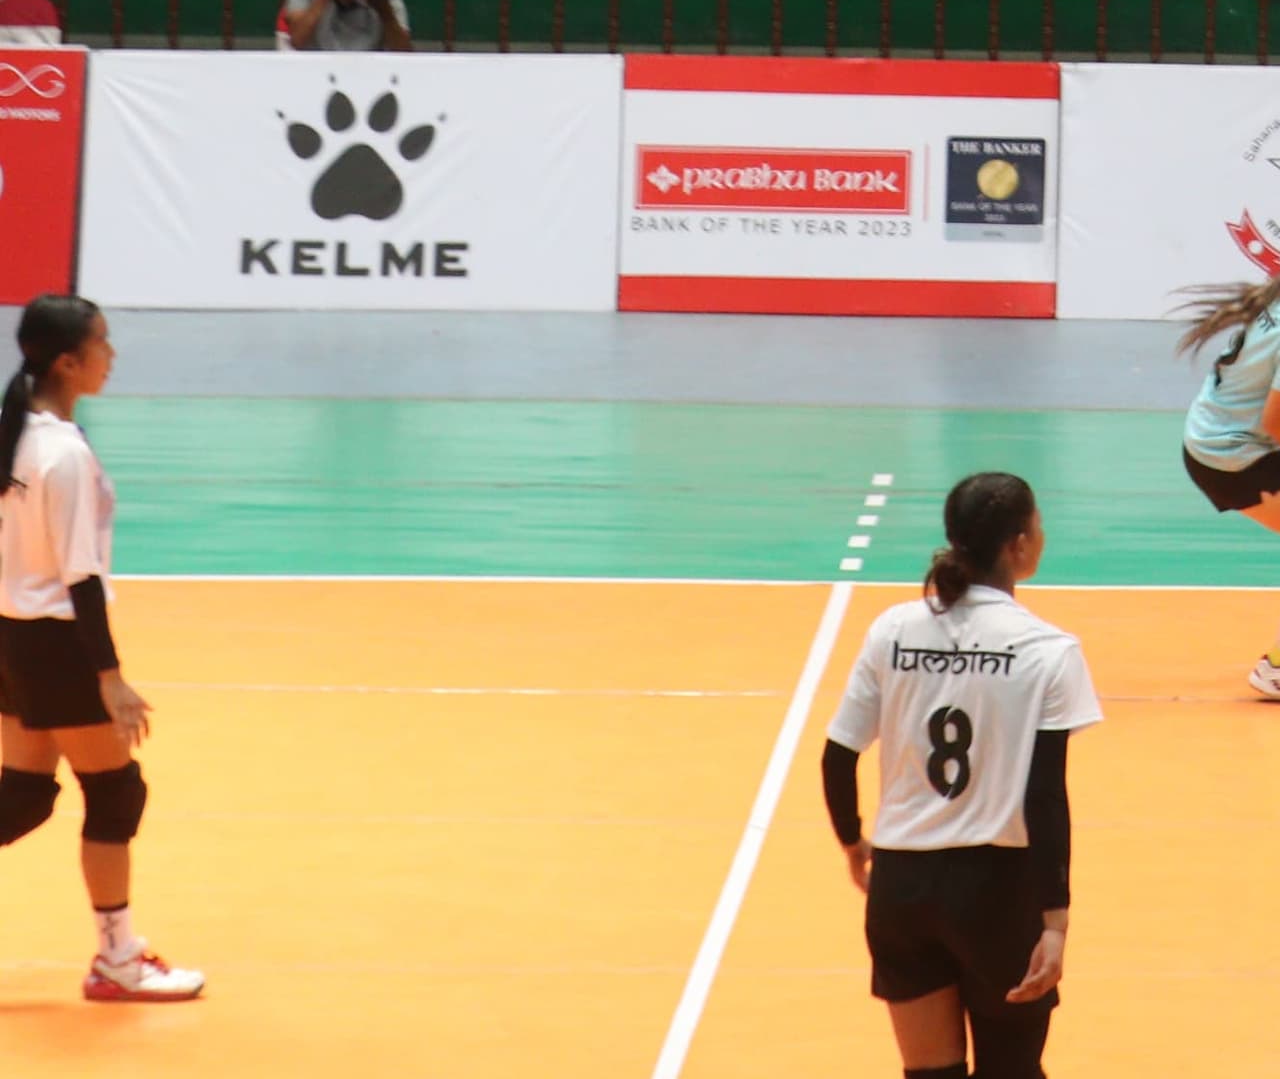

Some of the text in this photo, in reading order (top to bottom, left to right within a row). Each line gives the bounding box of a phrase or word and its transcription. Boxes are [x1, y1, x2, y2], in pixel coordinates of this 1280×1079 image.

[982, 141, 1042, 156] BANKER
[630, 216, 913, 237] BANK OF THE YEAR 2023
[240, 238, 469, 278] KELME
[926, 705, 973, 801] 8
